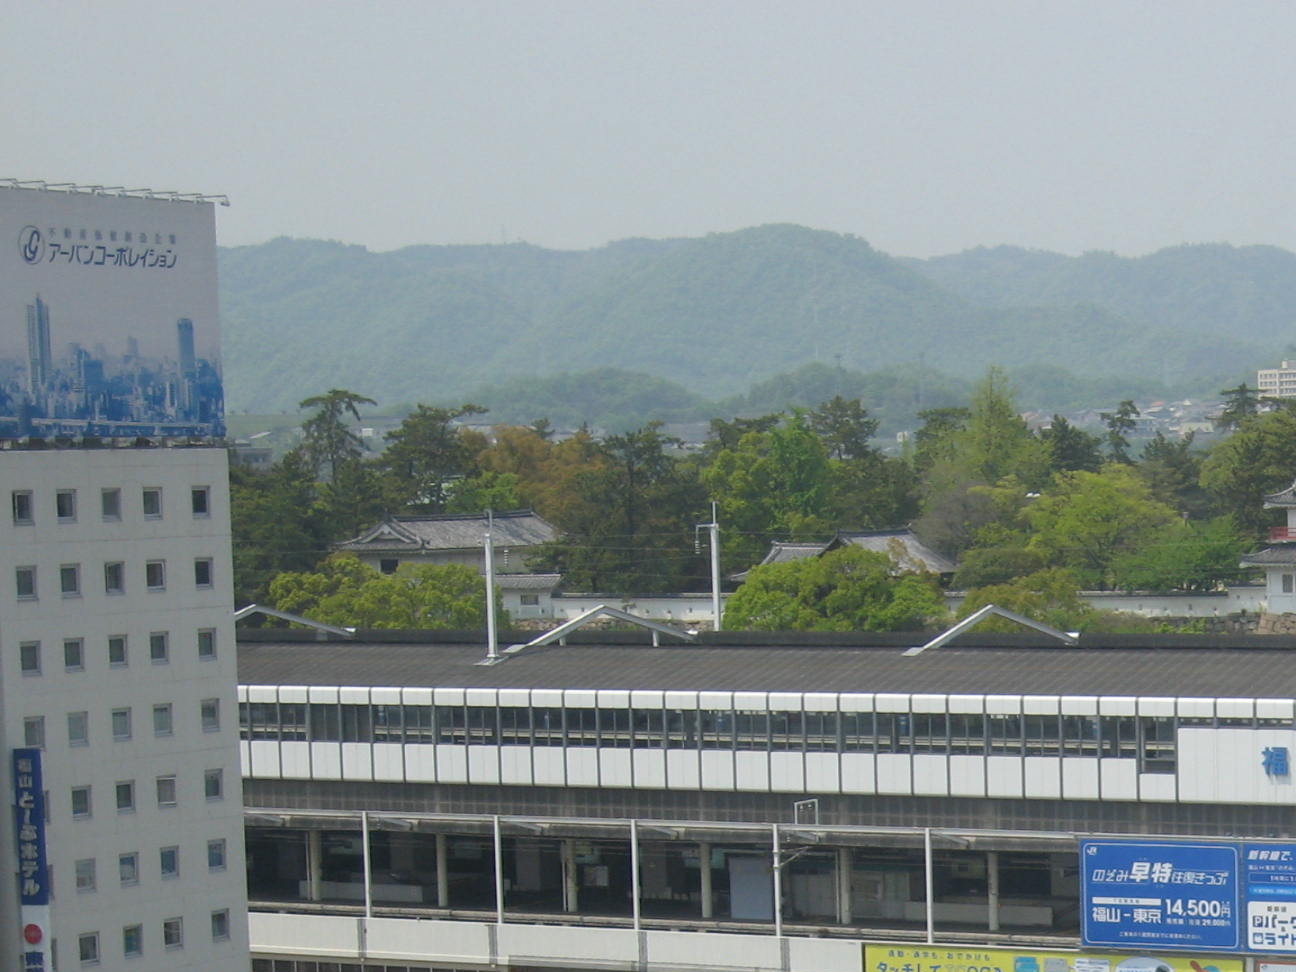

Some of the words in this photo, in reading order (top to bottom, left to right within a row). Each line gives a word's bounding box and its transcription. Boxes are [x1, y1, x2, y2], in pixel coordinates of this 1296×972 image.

[48, 243, 177, 268] アーバンコーポレイション
